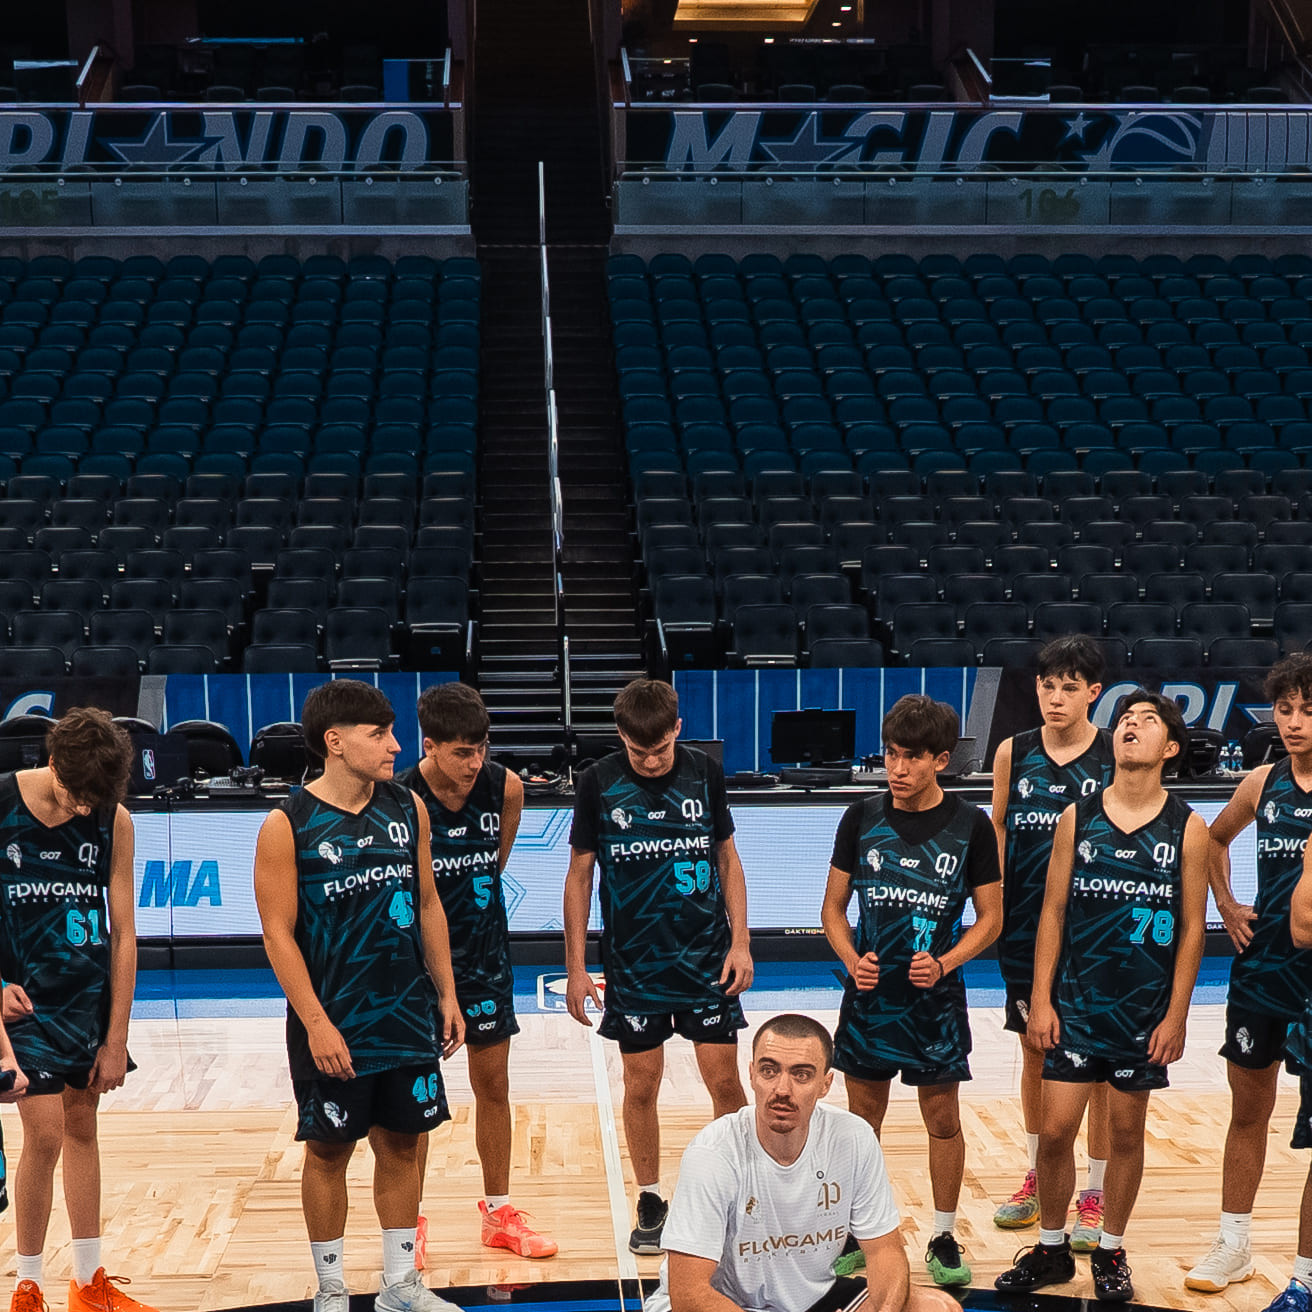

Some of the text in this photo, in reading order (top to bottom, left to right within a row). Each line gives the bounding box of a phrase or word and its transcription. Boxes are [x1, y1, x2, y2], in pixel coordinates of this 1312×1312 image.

[430, 848, 500, 872] OWGAM
[610, 836, 710, 857] FLOWGAME
[673, 860, 711, 895] 58
[1073, 877, 1174, 898] FLOWGAME
[66, 909, 102, 947] 61
[1129, 906, 1175, 947] 78
